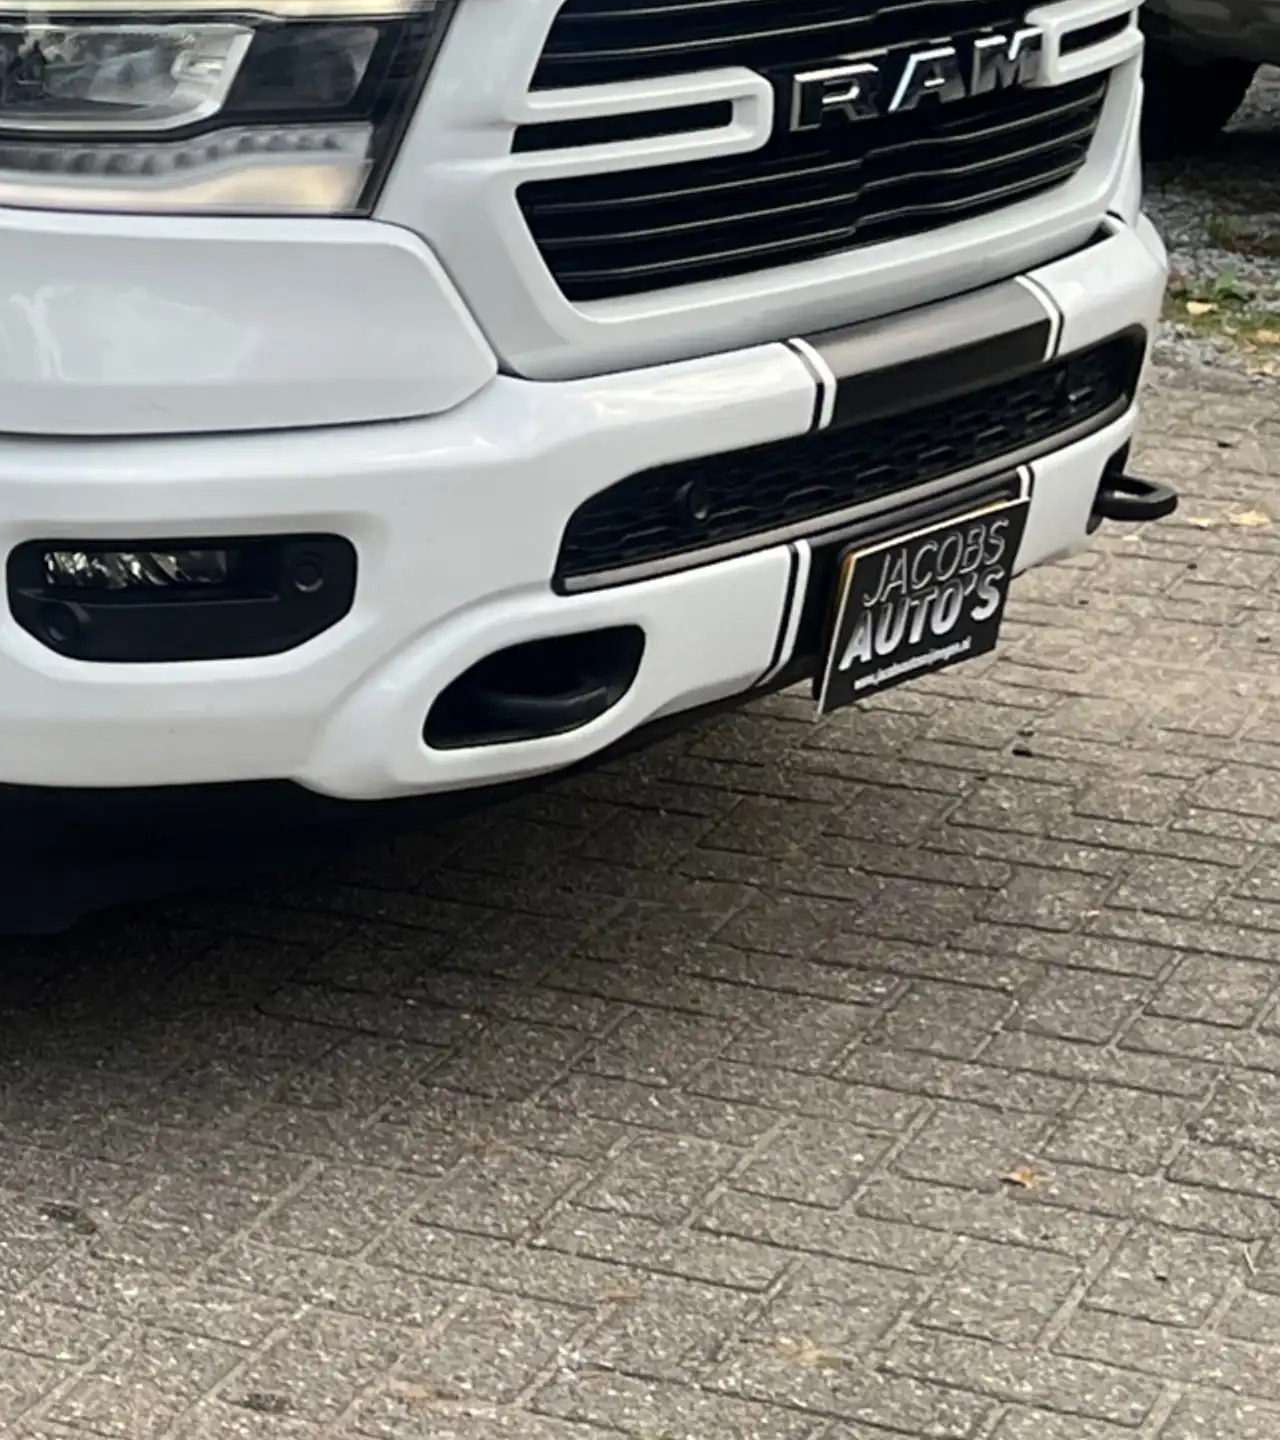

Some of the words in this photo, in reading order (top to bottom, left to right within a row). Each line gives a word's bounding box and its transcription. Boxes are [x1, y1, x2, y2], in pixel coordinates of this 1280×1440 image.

[789, 26, 1044, 132] RAM
[862, 516, 1010, 607] JACOBS
[838, 565, 1005, 671] AUTO'S
